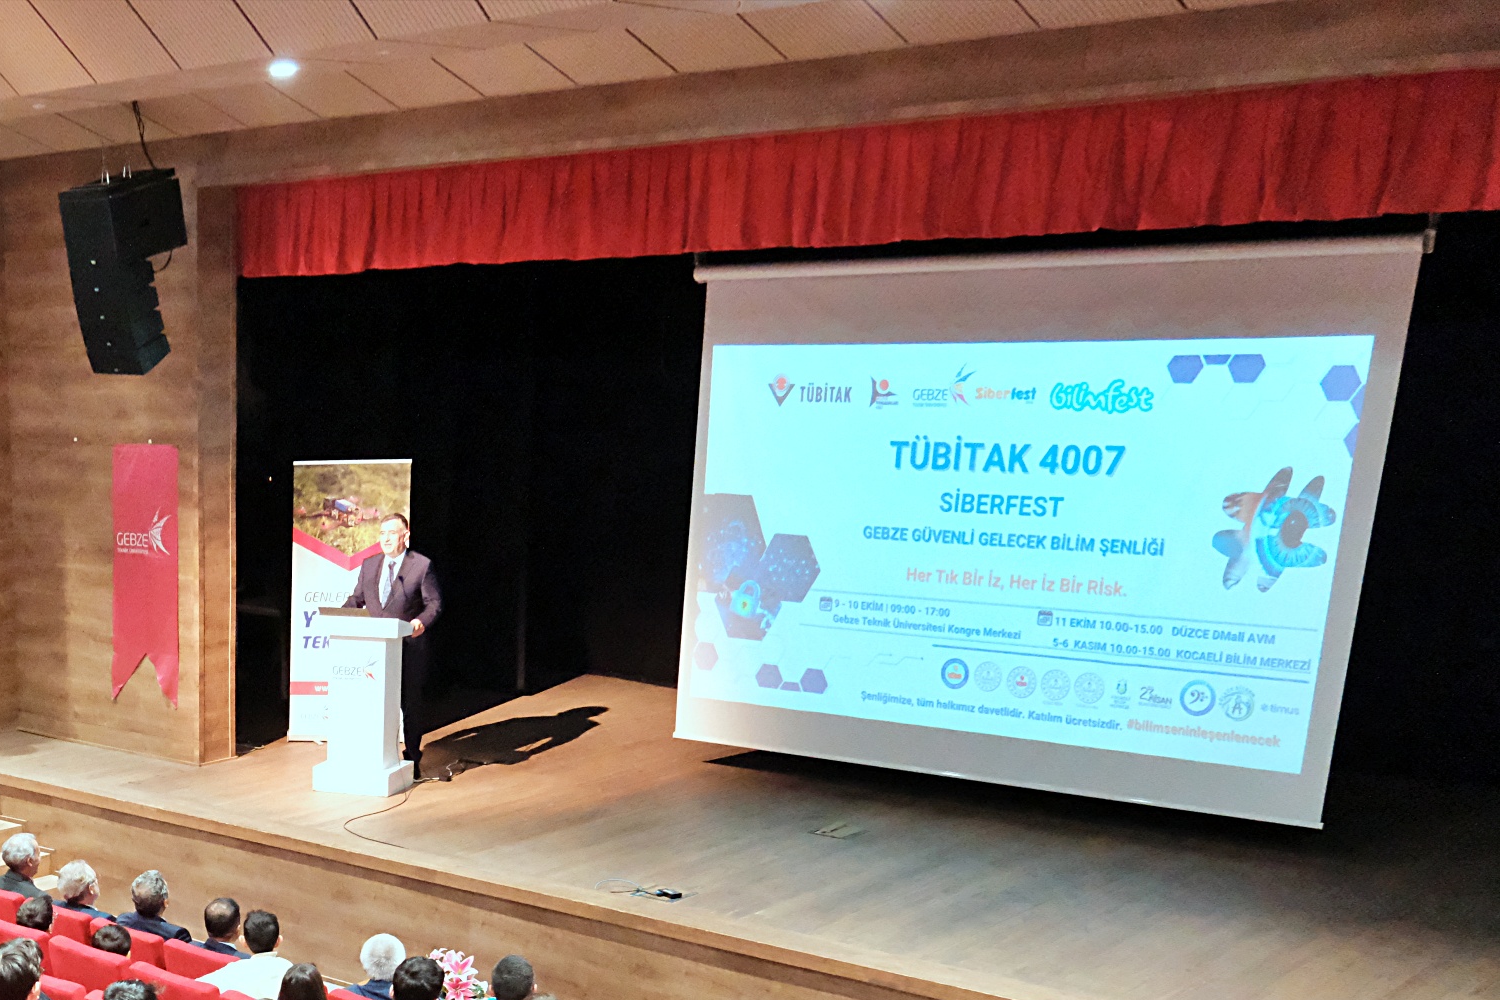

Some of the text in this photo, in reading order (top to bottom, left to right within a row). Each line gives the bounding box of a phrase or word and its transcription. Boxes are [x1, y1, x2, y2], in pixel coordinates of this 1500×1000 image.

[800, 382, 852, 403] TÜBİTAK
[912, 388, 949, 401] GEBZE
[975, 386, 1037, 401] Siberfest
[1049, 378, 1155, 415] bilimfest
[889, 434, 1127, 477] TÜBİTAK 4007
[939, 488, 1065, 518] SİBERFEST
[116, 532, 149, 548] GEBZE
[862, 525, 1166, 558] GEBZE GÜVENLİ GELECEK BİLİM ŞENLİĞİ
[905, 566, 933, 583] Her
[936, 569, 959, 585] Tık
[1009, 574, 1038, 591] Her
[848, 600, 859, 610] 10
[860, 600, 884, 612] EKİM
[890, 604, 916, 615] 09:00
[925, 606, 951, 618] 17:00
[832, 613, 1022, 640] Gebze Teknik Üniversitesi Kongre Merkezi
[1054, 617, 1067, 628] 11
[1069, 616, 1097, 630] EKİM
[1099, 620, 1163, 635] 10.00-15.00
[1171, 624, 1210, 640] DÜZCE
[1247, 633, 1276, 645] AVM
[1052, 637, 1312, 672] 5-6 KASIM 10.00-15.00 KOCAELİ BİLİM MERKEZİ
[332, 665, 362, 677] GEBZE
[860, 690, 914, 708] Şenliğimize,
[916, 697, 934, 709] tüm
[936, 699, 976, 713] halkımız
[978, 703, 1026, 720] davetlidir.
[1027, 710, 1063, 724] Katılım
[1065, 714, 1123, 731] ücretsizdir.
